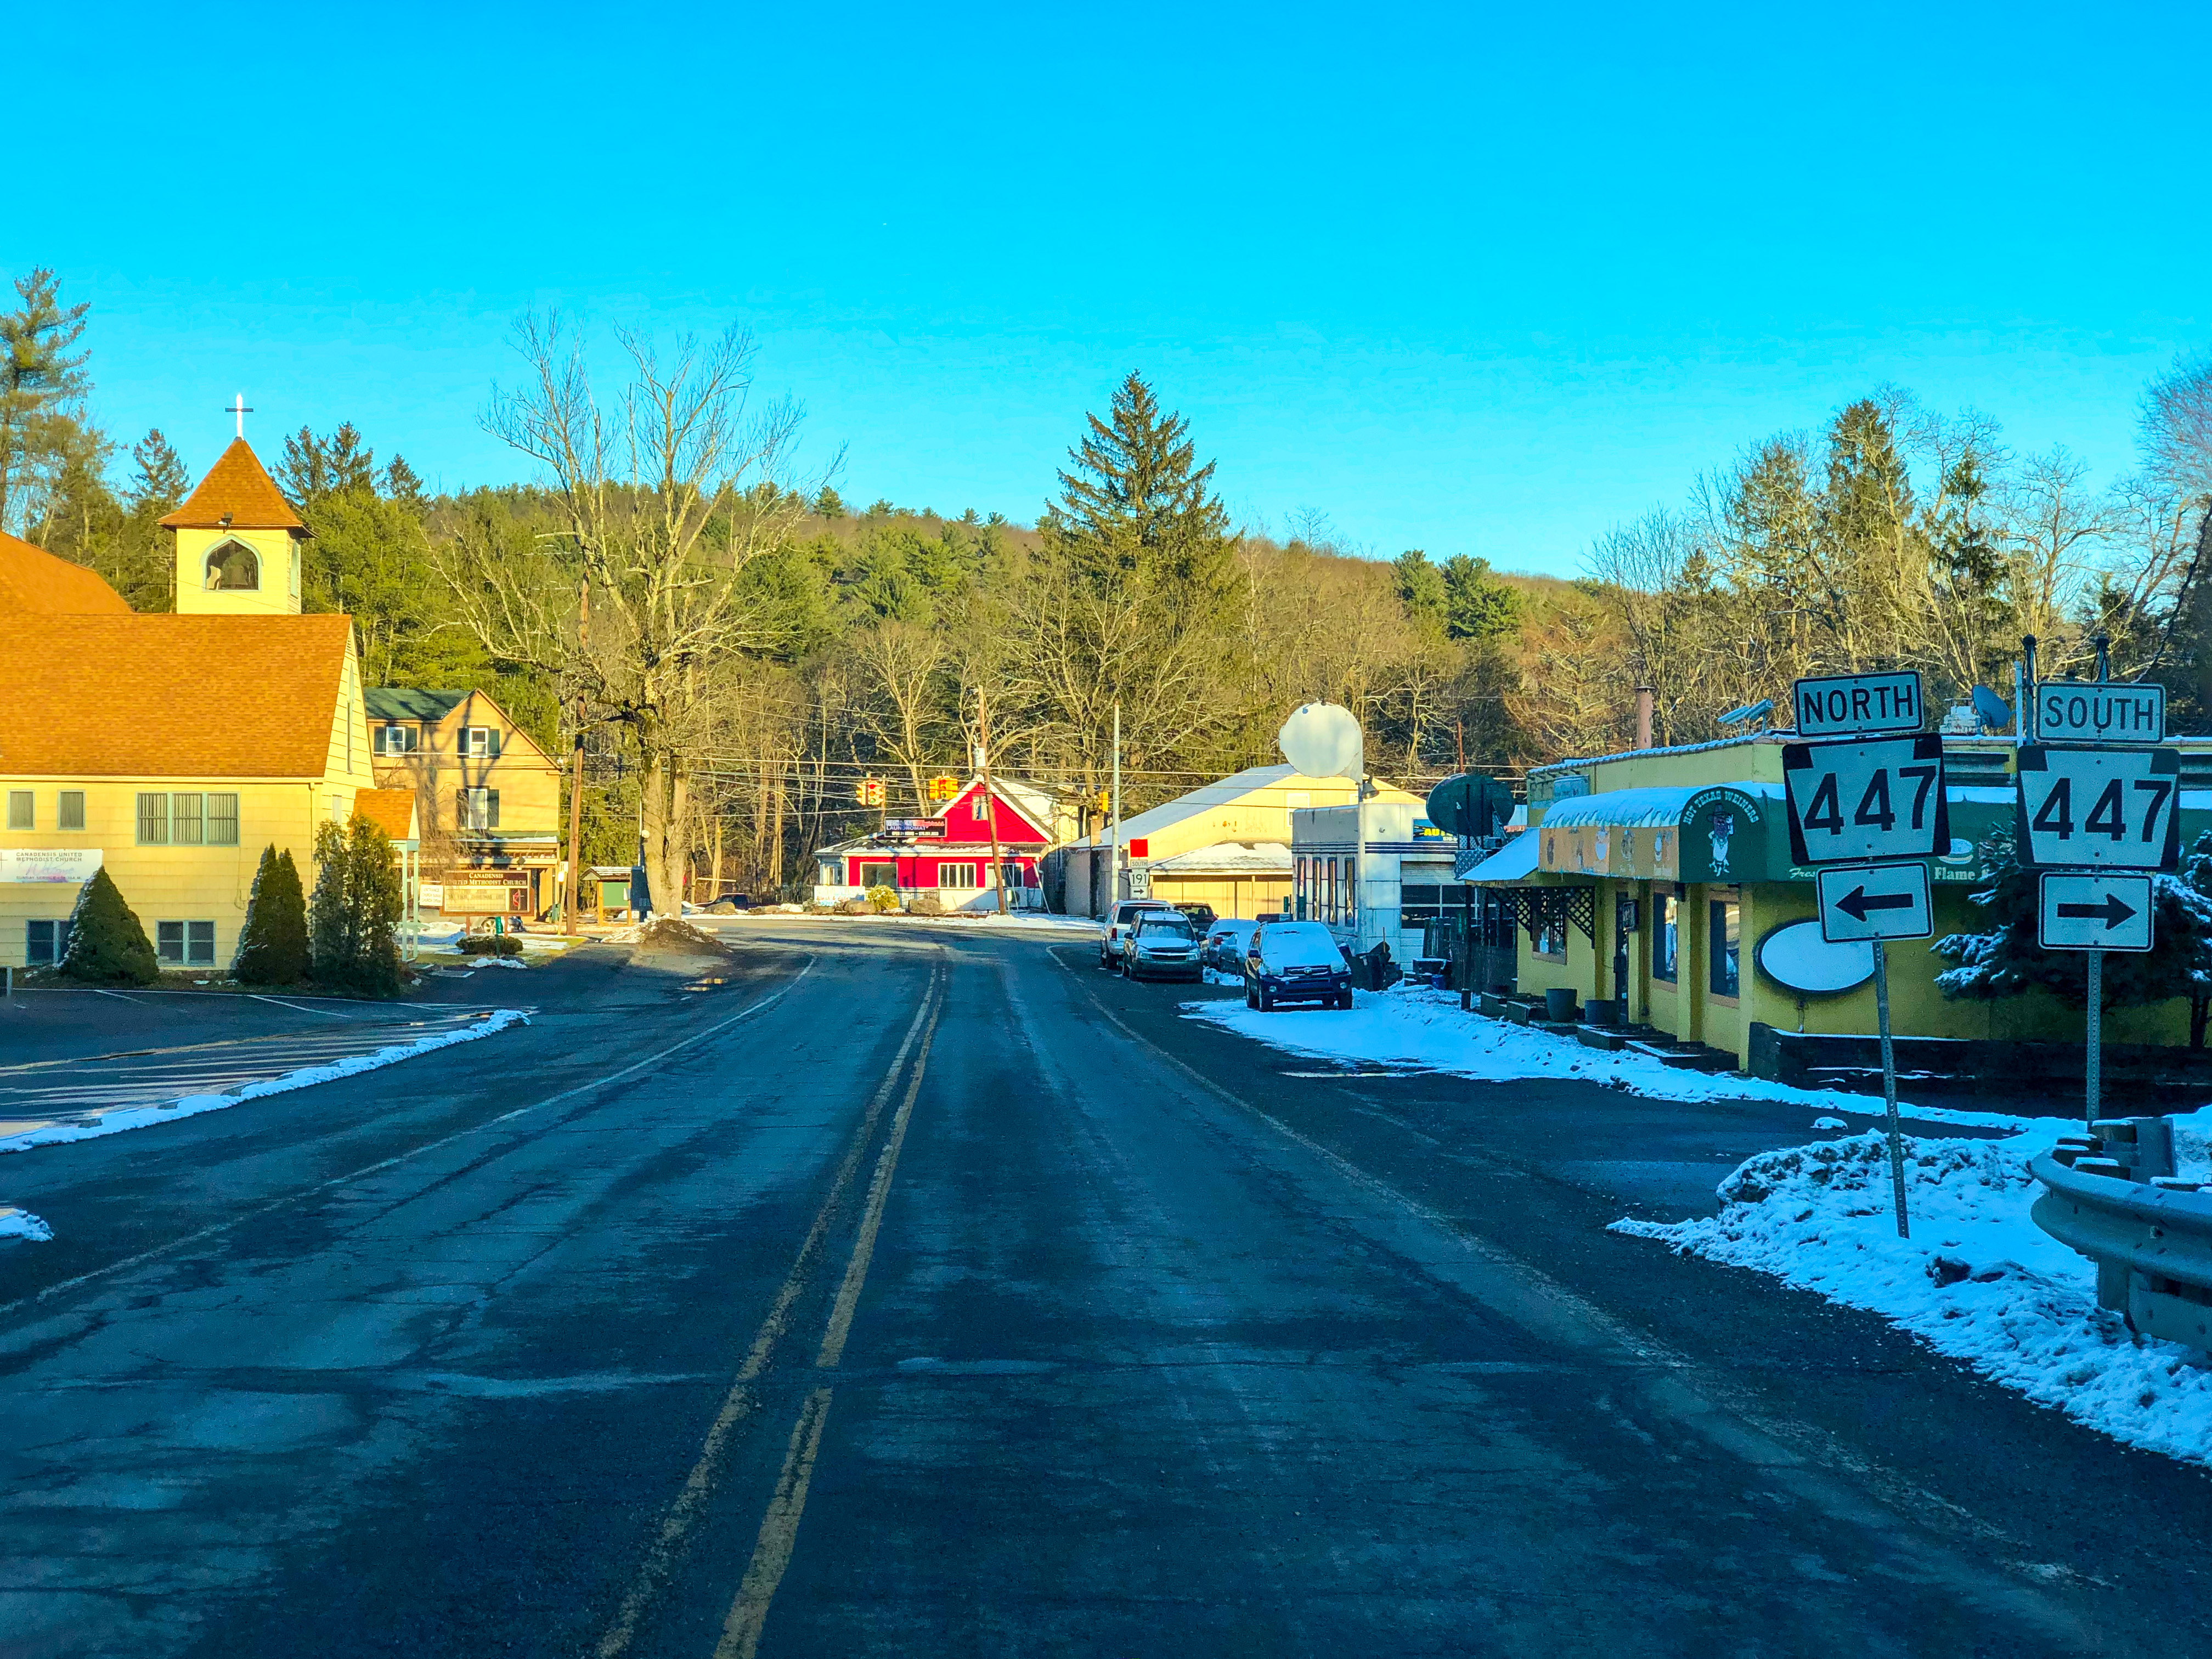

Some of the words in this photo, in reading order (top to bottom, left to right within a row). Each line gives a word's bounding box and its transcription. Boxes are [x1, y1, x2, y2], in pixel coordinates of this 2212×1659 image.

[1803, 684, 1914, 724] NORTH
[2044, 696, 2153, 731] SOUTH
[1683, 805, 1697, 825] HOT
[1694, 790, 1721, 808] TEXAS
[1724, 791, 1759, 823] WEINERS
[1803, 765, 1937, 835] 447
[2033, 777, 2172, 842] 447
[1132, 874, 1147, 884] 191
[1934, 867, 1976, 881] Flame
